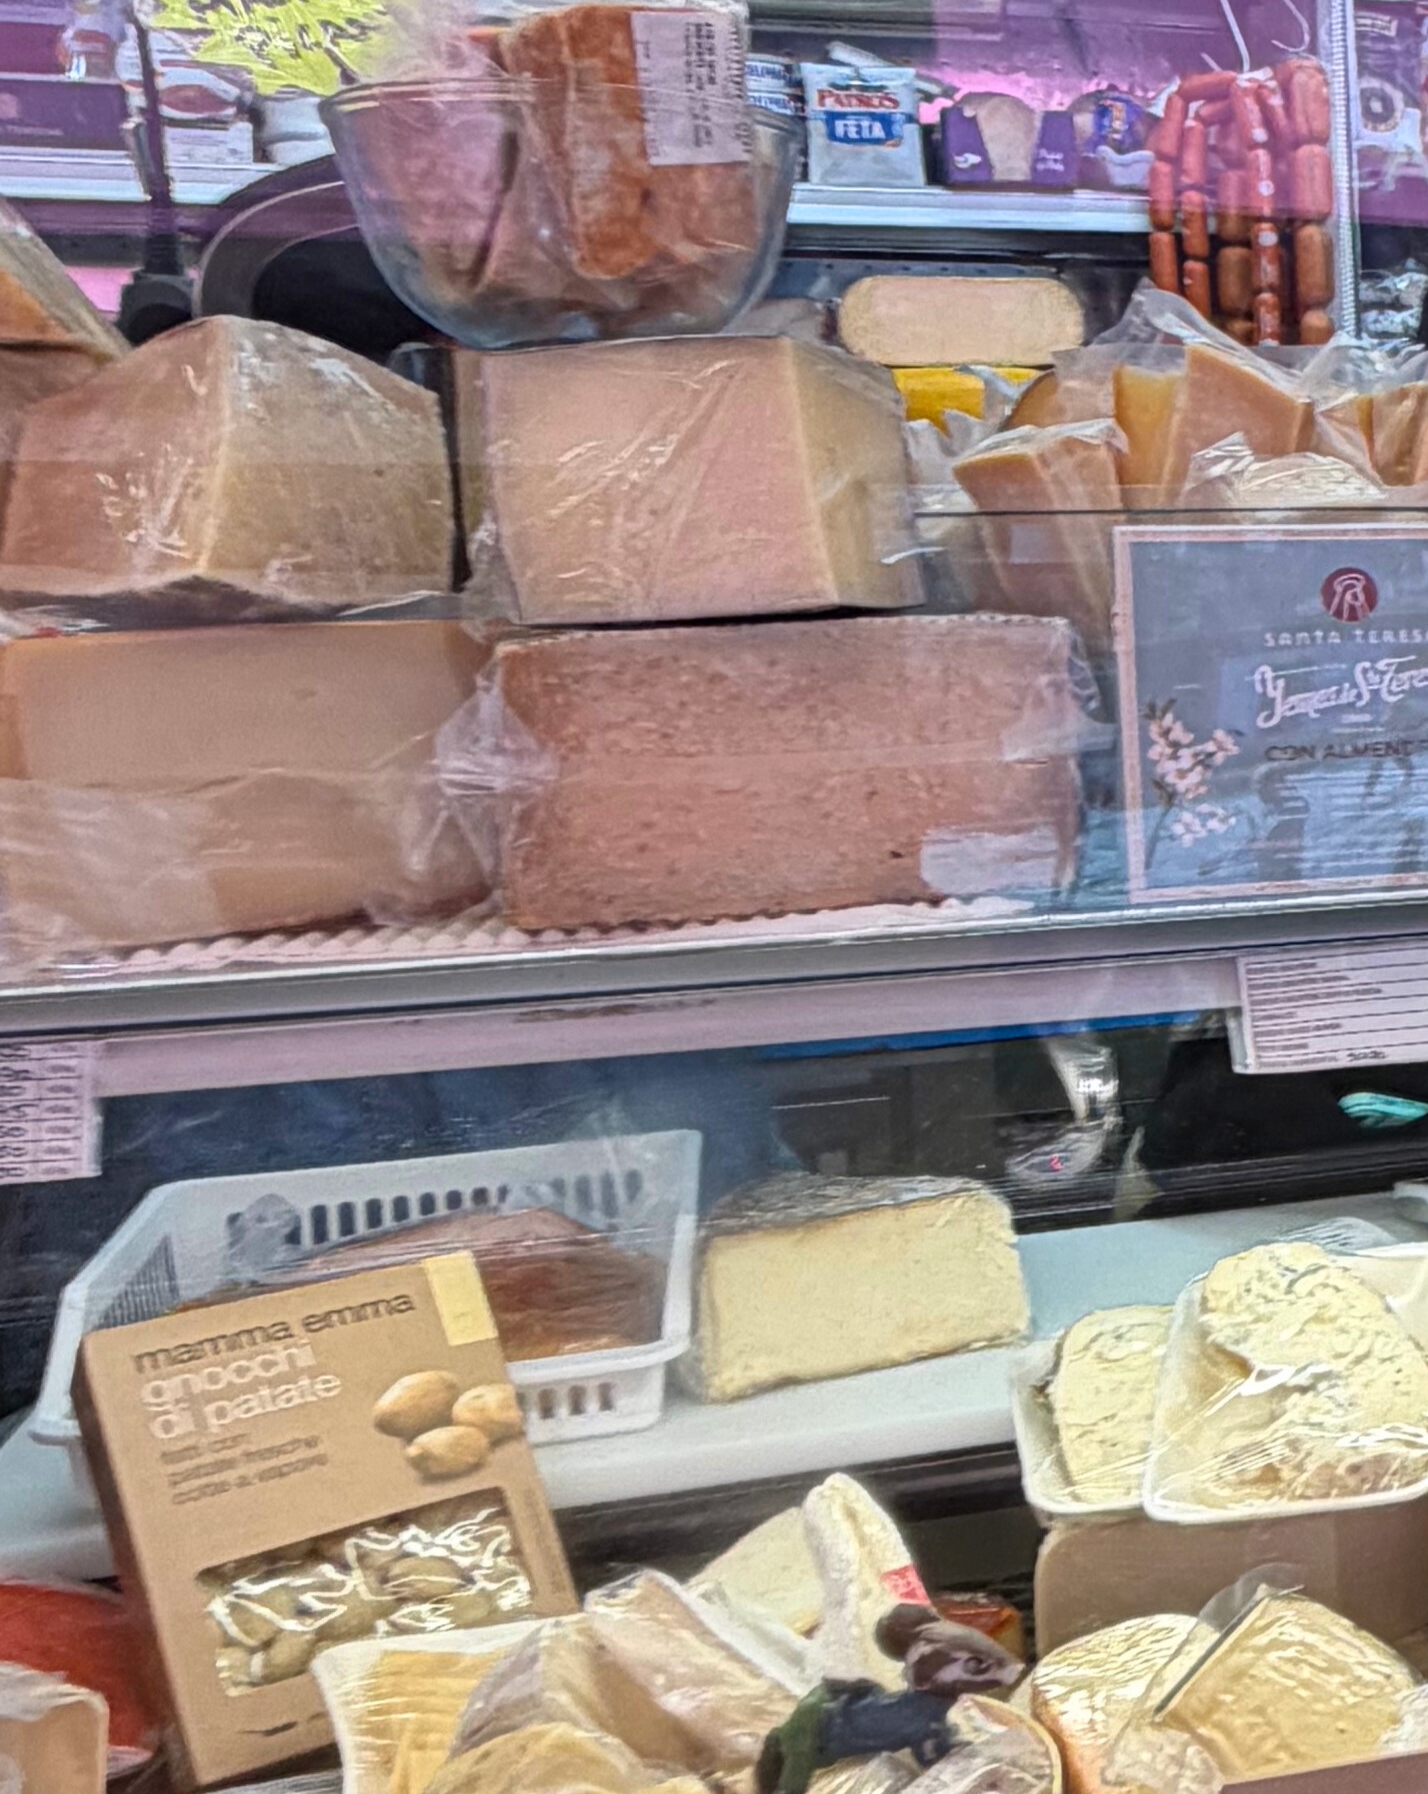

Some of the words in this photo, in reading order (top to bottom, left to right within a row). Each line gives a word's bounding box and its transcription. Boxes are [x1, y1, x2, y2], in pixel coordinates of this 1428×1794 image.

[834, 117, 887, 142] FETA
[133, 1312, 298, 1374] mamma
[300, 1289, 418, 1338] emma
[149, 1402, 201, 1441] di
[203, 1370, 345, 1434] patate
